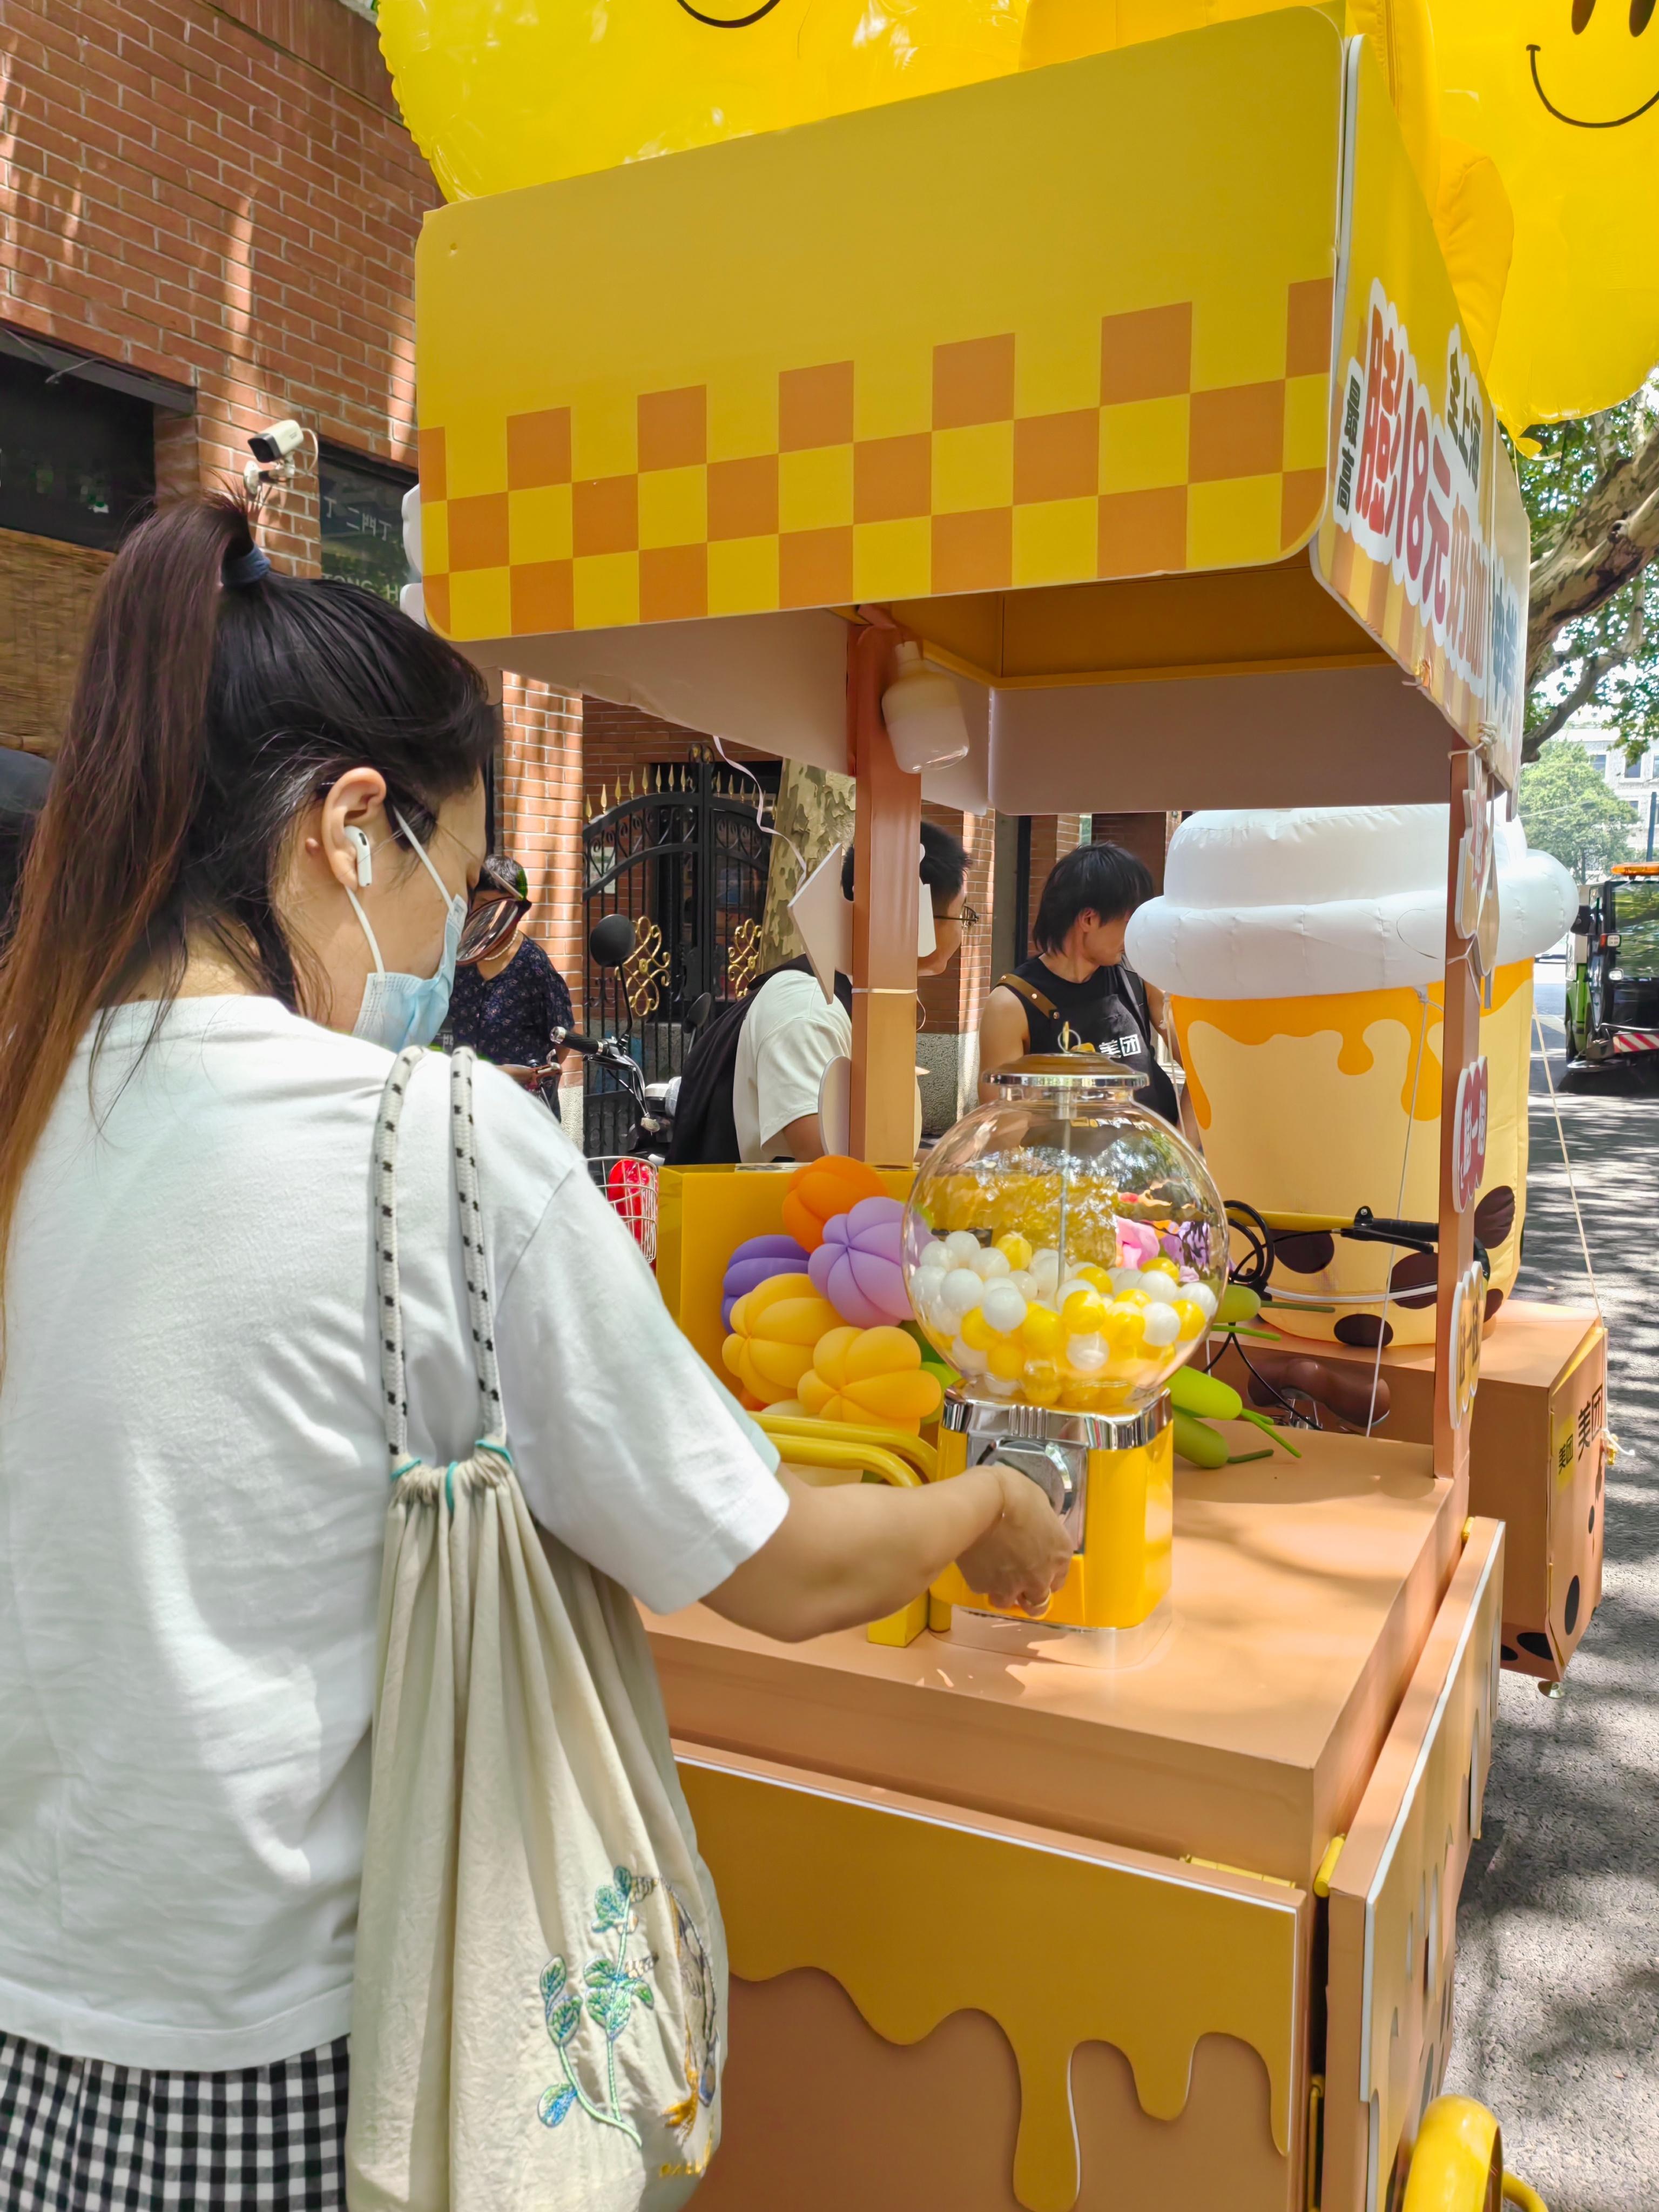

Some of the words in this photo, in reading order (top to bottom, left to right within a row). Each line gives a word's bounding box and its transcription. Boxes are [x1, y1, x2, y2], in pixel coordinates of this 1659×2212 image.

[1447, 347, 1481, 494] 全上海
[1337, 375, 1361, 516] 最高
[1355, 304, 1451, 625] 膨18元
[1098, 1034, 1142, 1058] 美团
[1558, 1433, 1574, 1475] 美团
[1578, 1382, 1603, 1462] 美团
